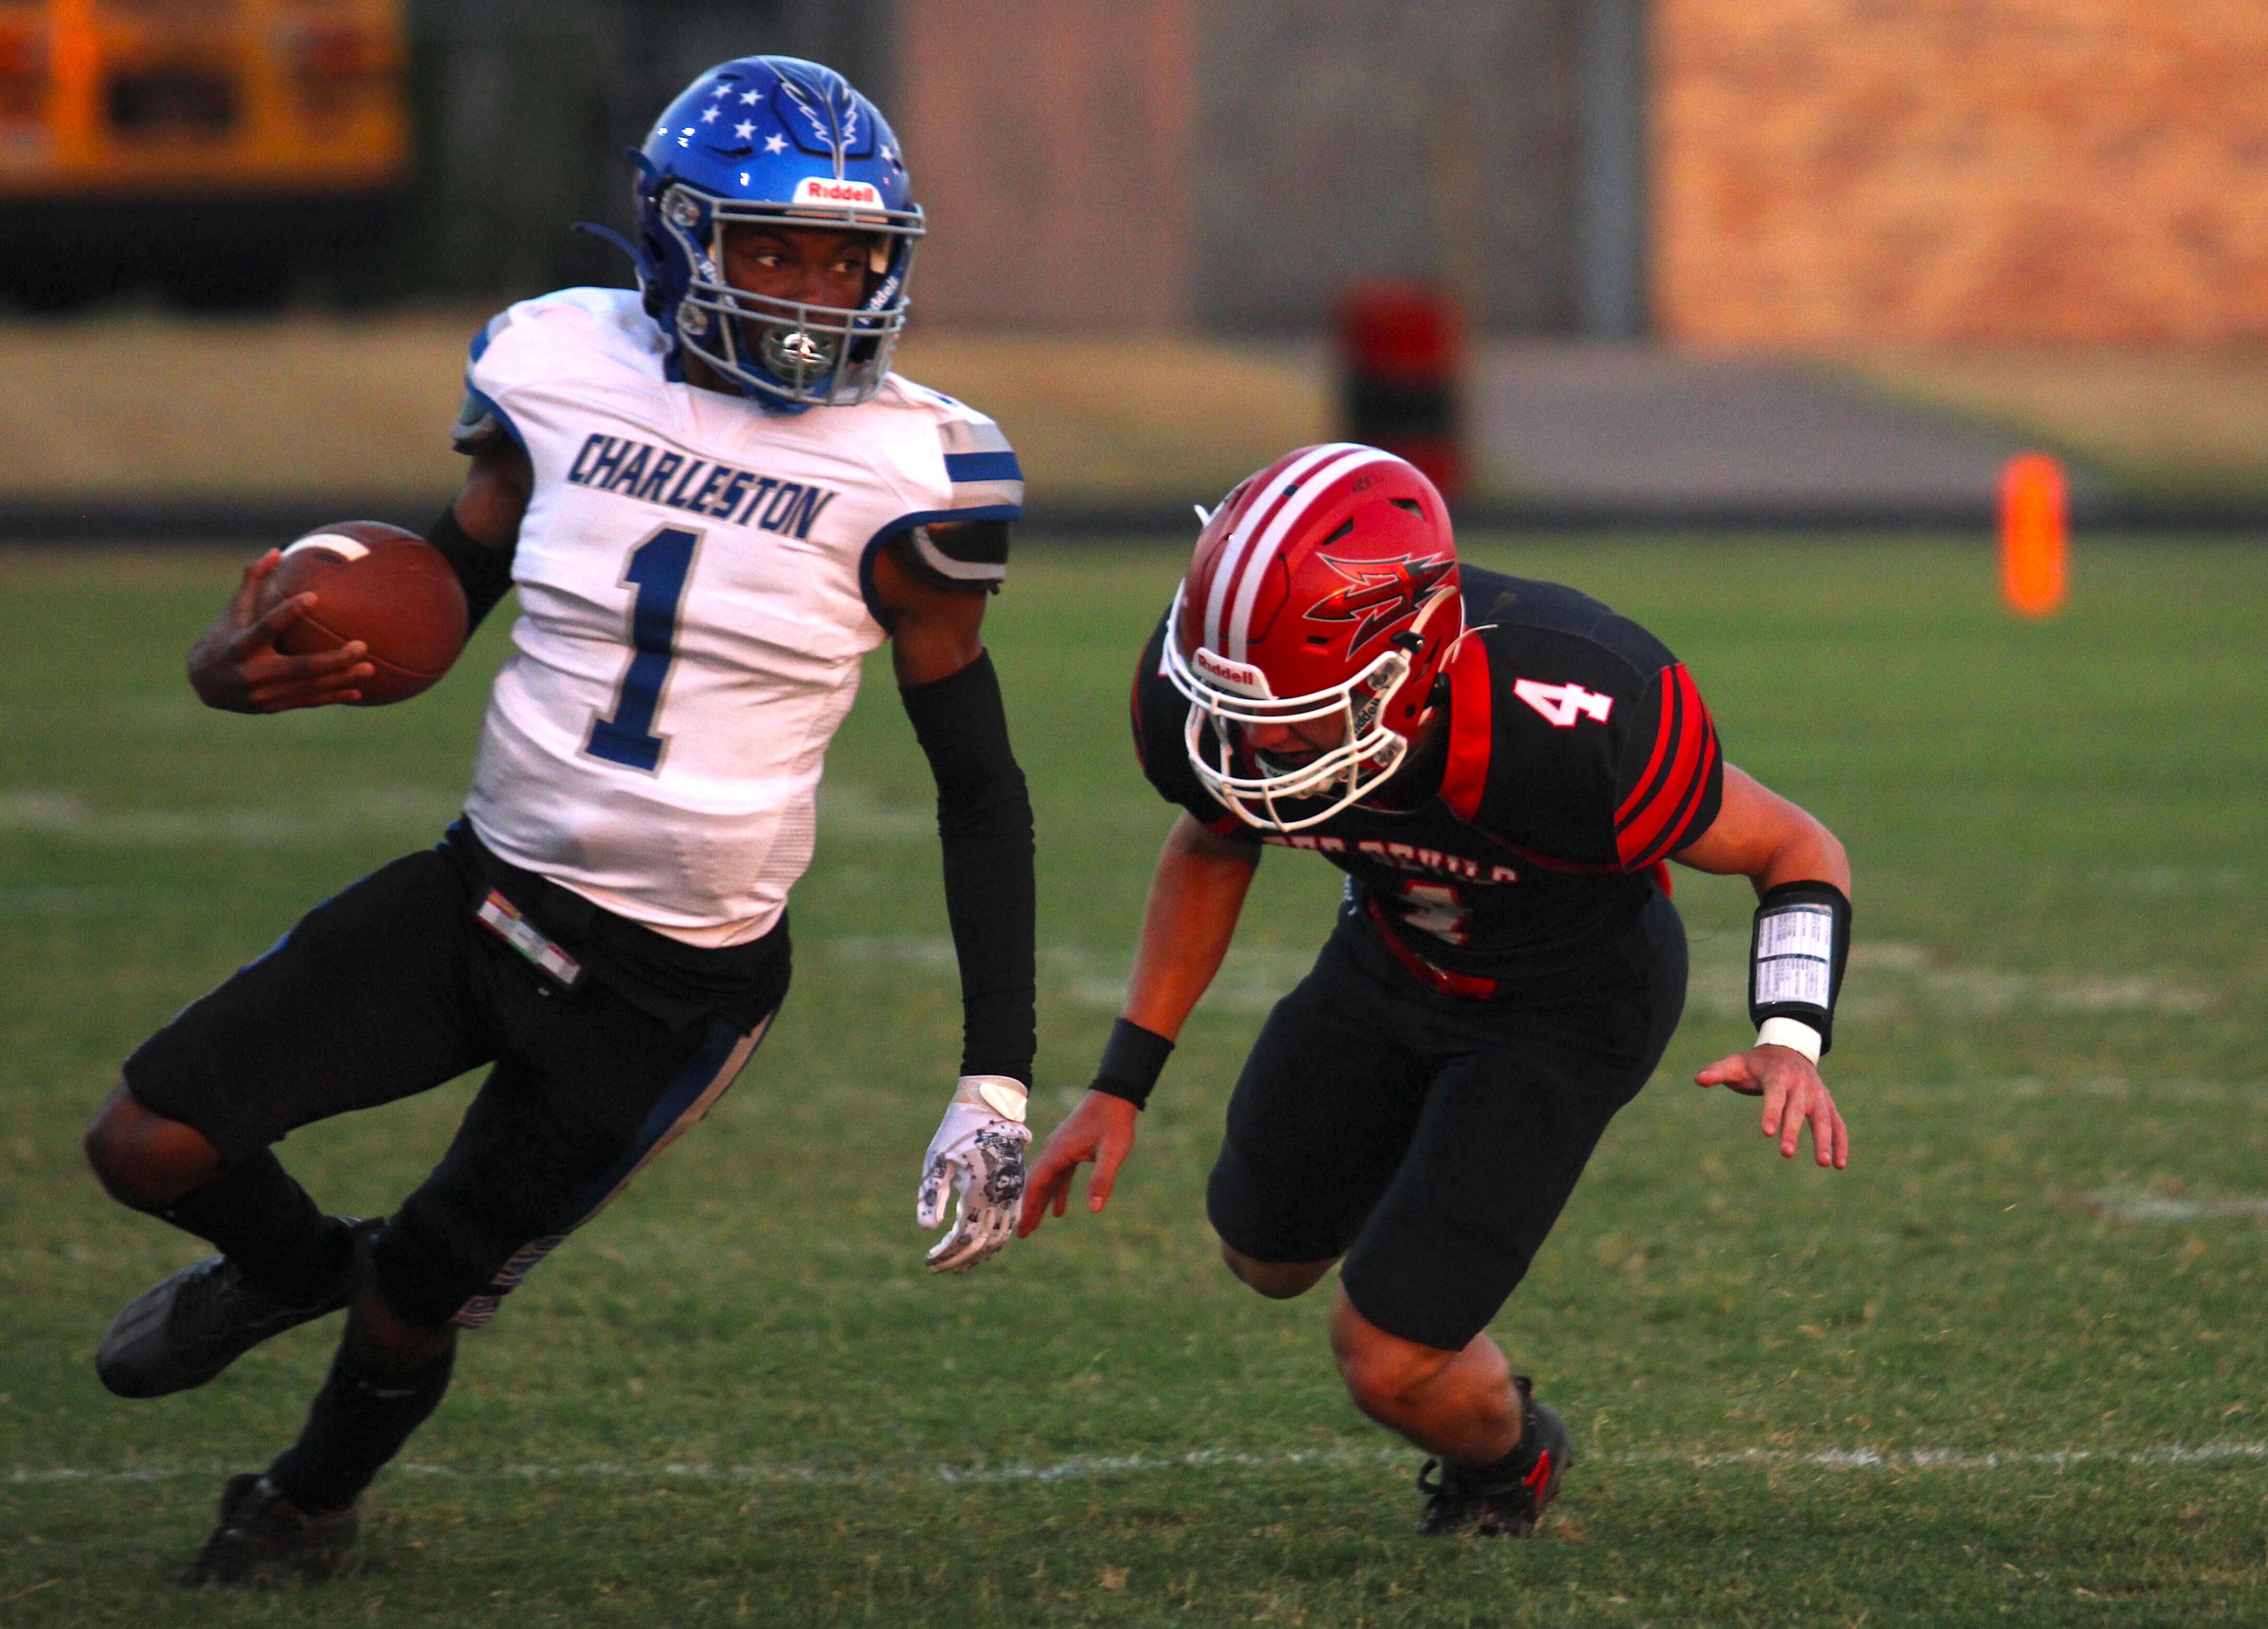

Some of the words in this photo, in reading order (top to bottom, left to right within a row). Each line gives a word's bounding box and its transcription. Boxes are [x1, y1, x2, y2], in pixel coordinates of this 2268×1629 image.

[808, 181, 874, 203] Riddell
[566, 432, 840, 540] CHARLESTON
[575, 520, 708, 779] 1
[1198, 654, 1253, 685] Riddell
[1512, 677, 1614, 728] 4
